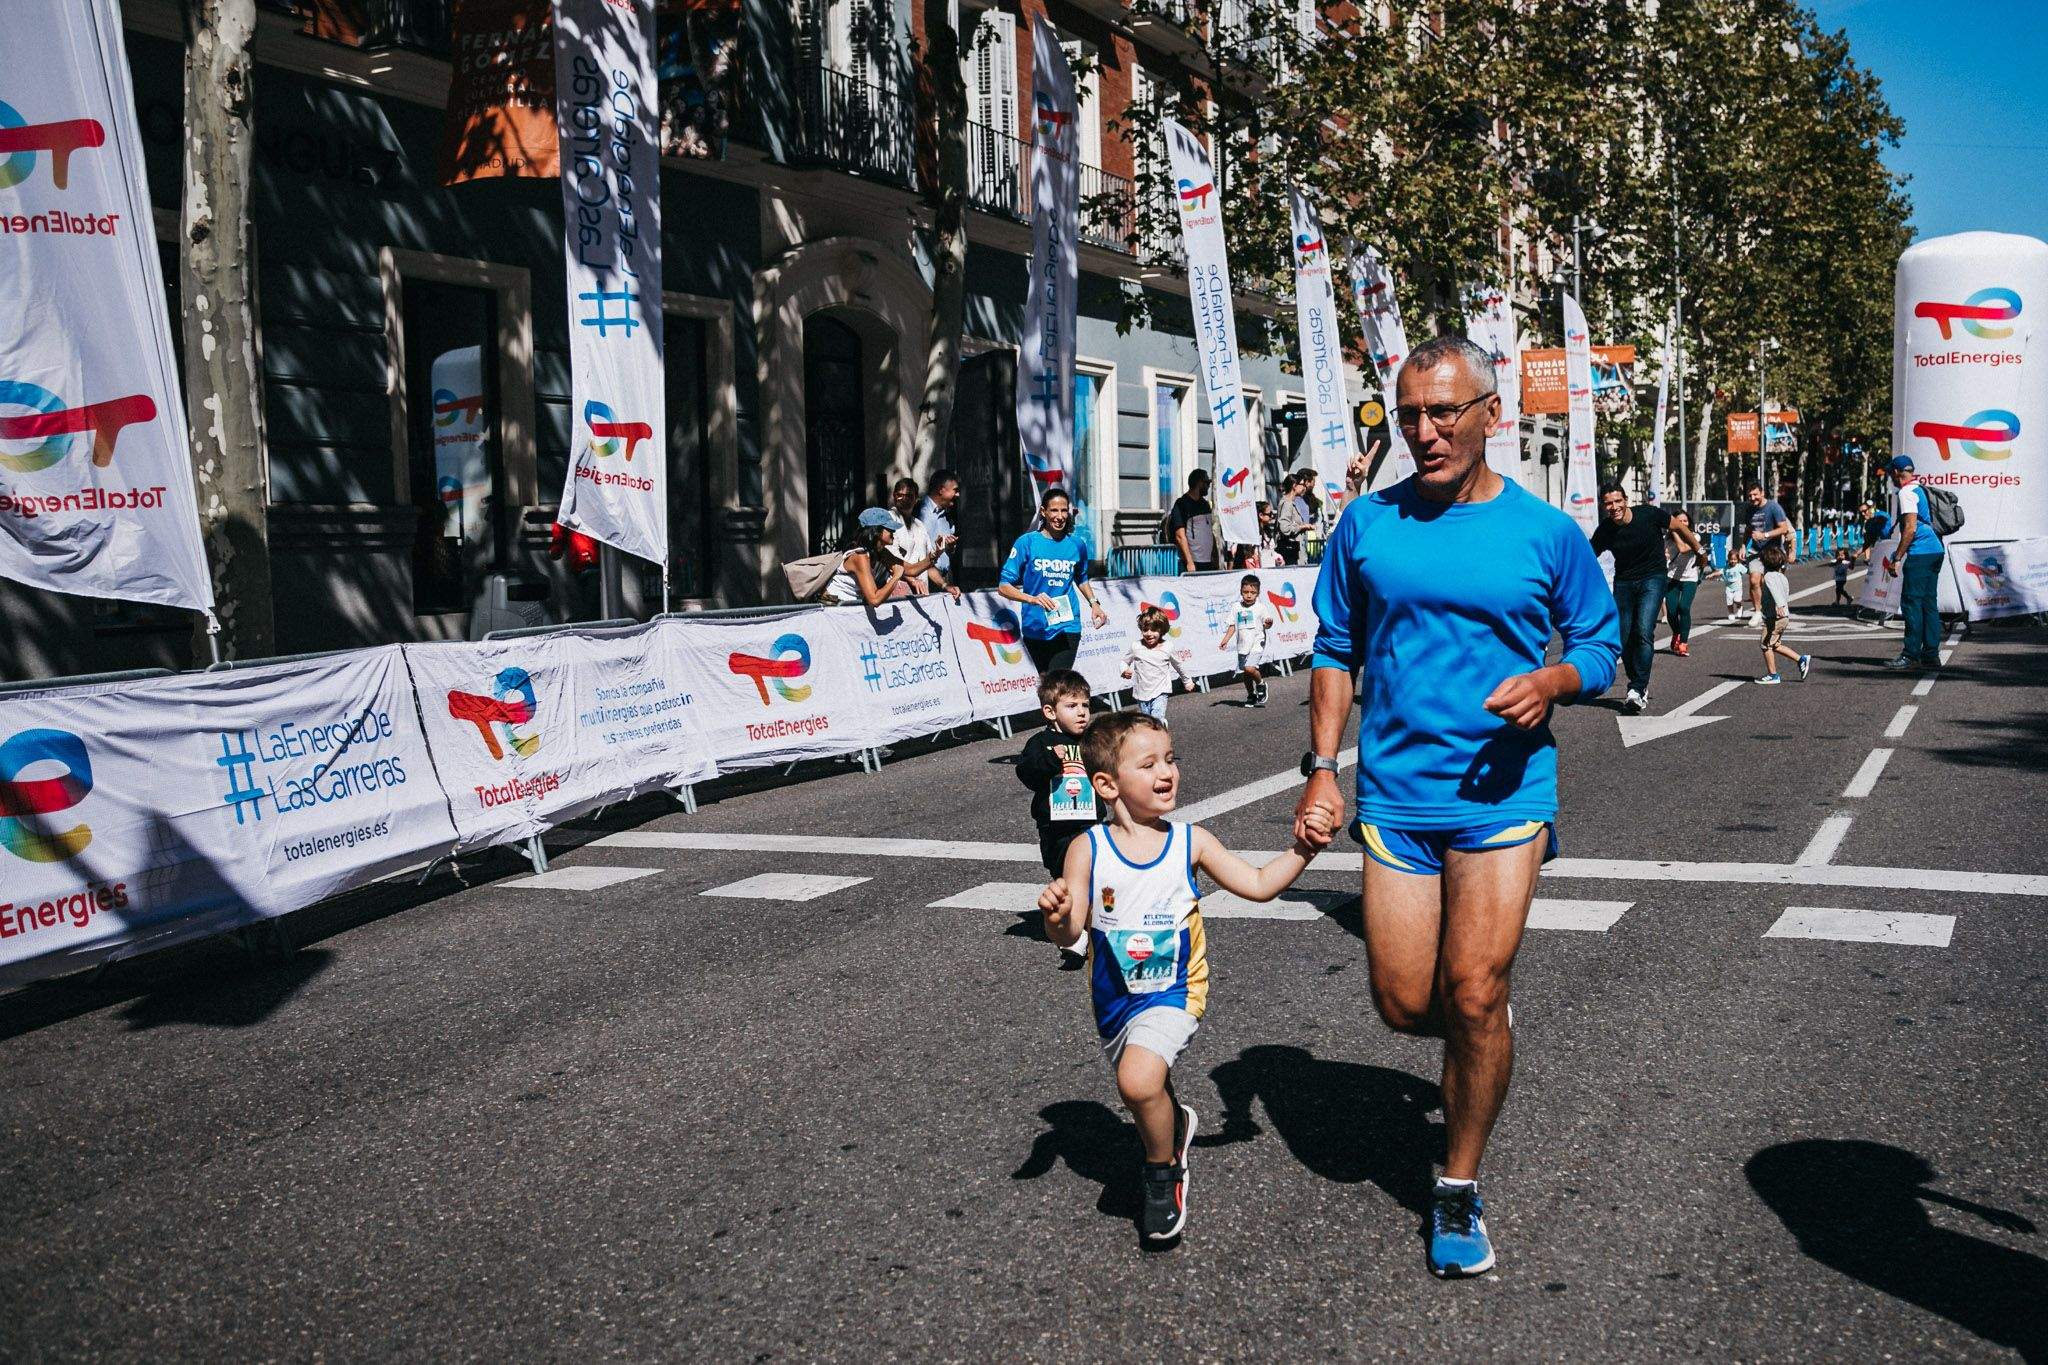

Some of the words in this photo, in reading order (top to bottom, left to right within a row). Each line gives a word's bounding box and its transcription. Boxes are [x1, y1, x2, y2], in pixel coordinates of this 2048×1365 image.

[1914, 350, 2022, 367] TotalEnergies
[1911, 472, 2021, 488] TotalEnergies
[1694, 520, 1721, 534] ICÉS
[1033, 558, 1077, 572] SPORT
[1042, 570, 1070, 581] Running
[1047, 579, 1064, 587] Club
[883, 660, 948, 689] LasCarreras
[980, 674, 1037, 695] TotalEnergies
[639, 702, 654, 718] que
[746, 713, 830, 743] TotalEnergies
[267, 756, 407, 815] LasCarreras
[284, 820, 389, 862] totalenergies.es
[0, 883, 129, 939] Energies
